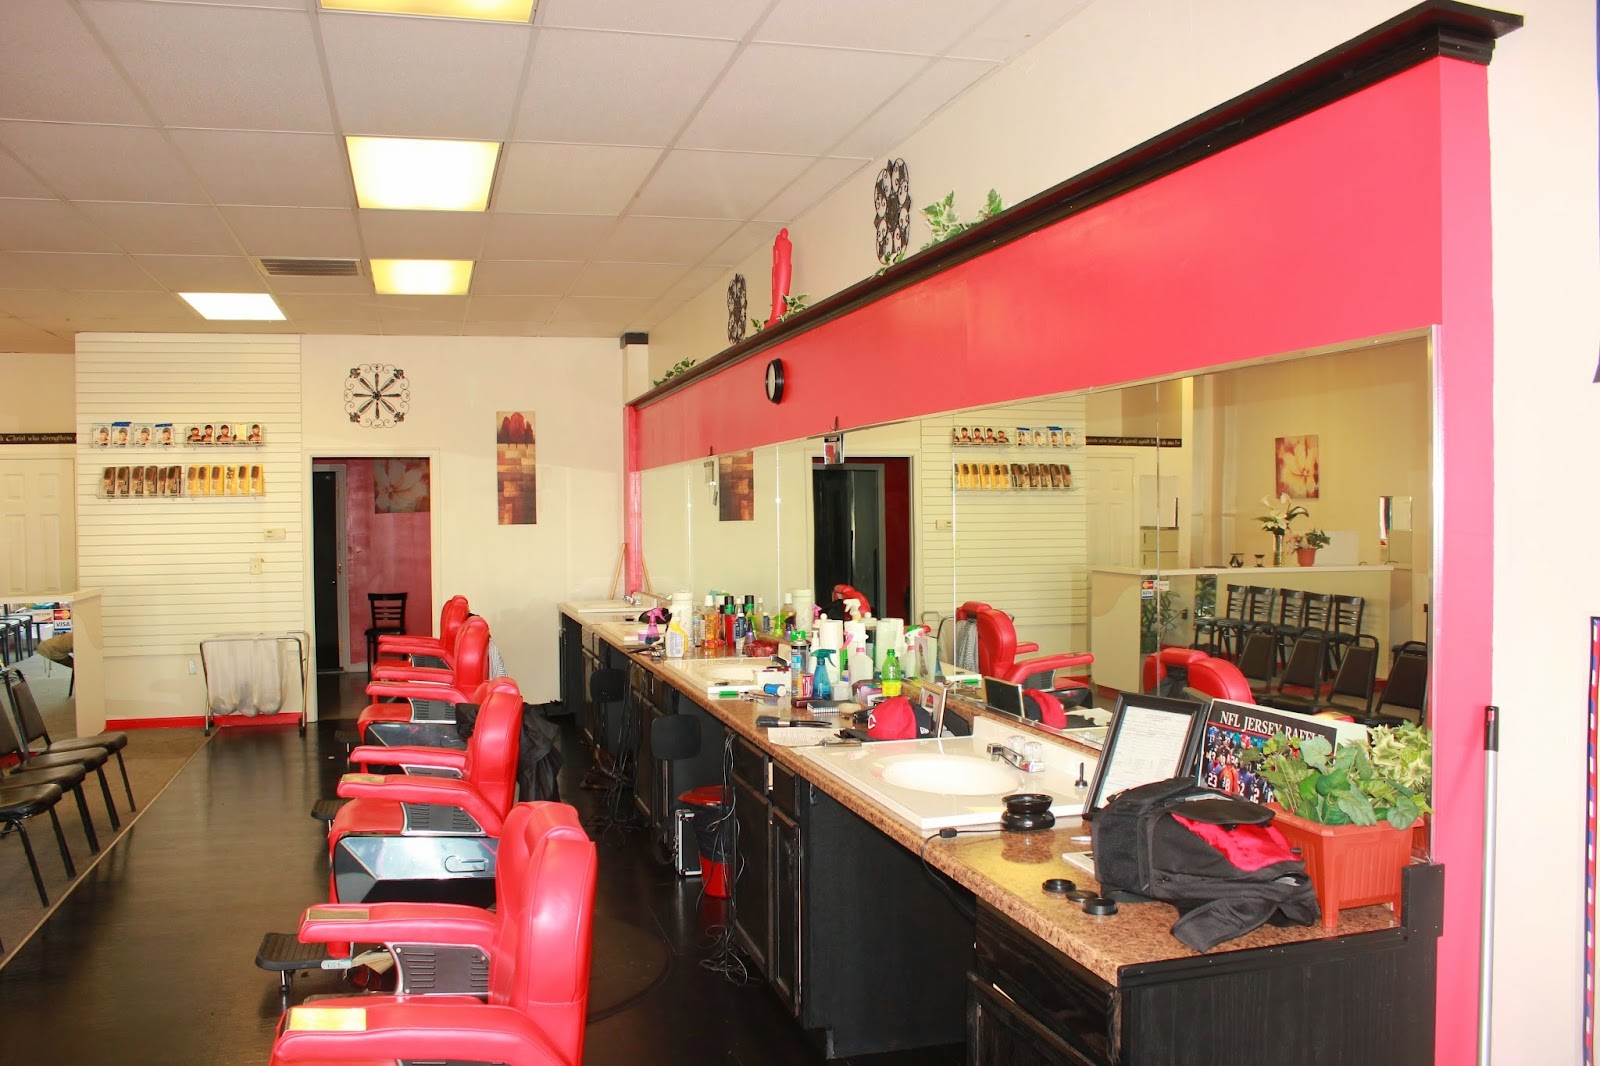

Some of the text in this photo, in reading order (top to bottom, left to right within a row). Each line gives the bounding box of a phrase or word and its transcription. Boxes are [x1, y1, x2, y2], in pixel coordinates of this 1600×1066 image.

[42, 434, 73, 442] strengthens
[1220, 710, 1325, 742] NFL JERSEY RAFFL
[1207, 773, 1218, 788] 23
